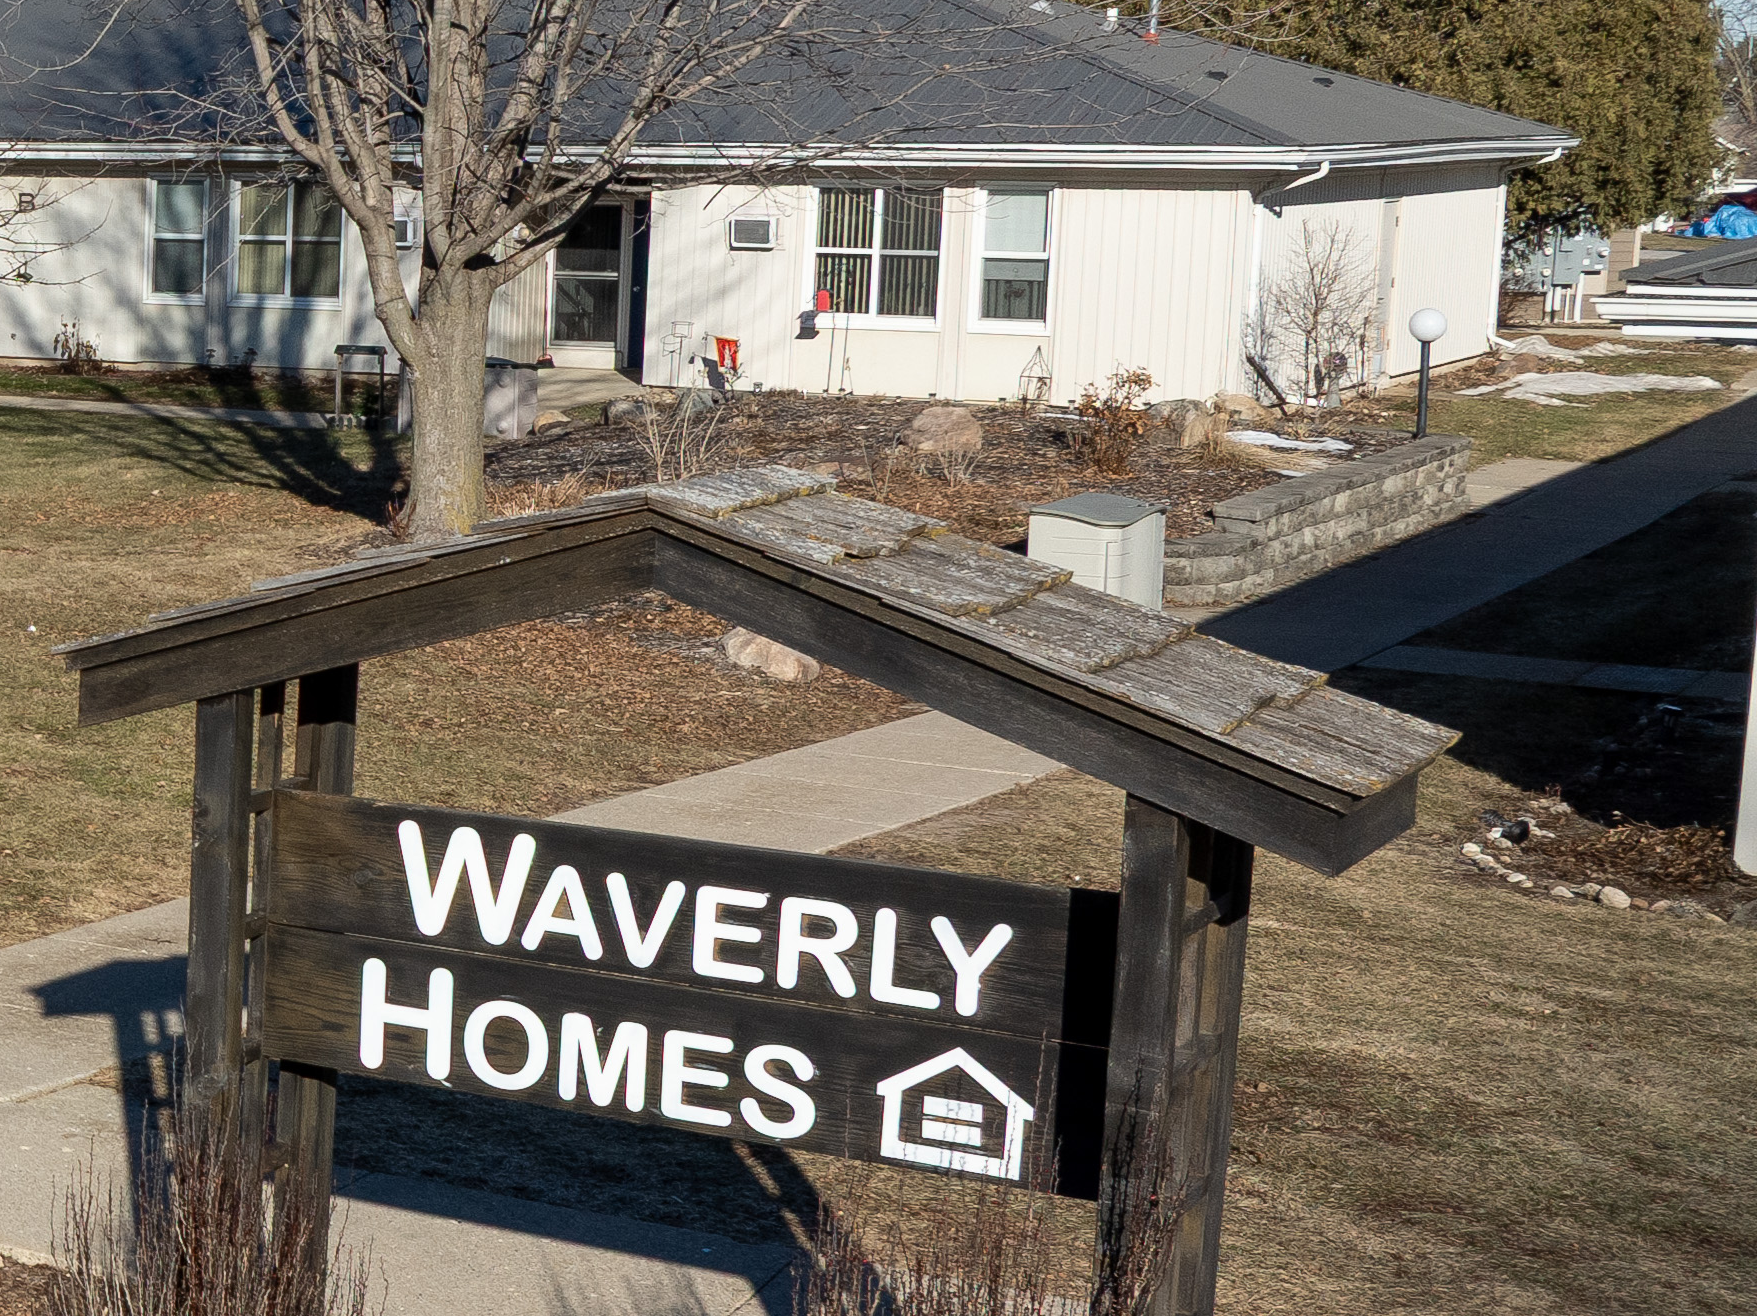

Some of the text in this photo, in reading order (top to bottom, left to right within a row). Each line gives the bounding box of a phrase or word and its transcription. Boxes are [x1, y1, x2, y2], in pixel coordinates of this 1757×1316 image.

[18, 192, 36, 212] B
[398, 819, 1013, 1017] WAVERLY
[360, 957, 816, 1139] HOMES
